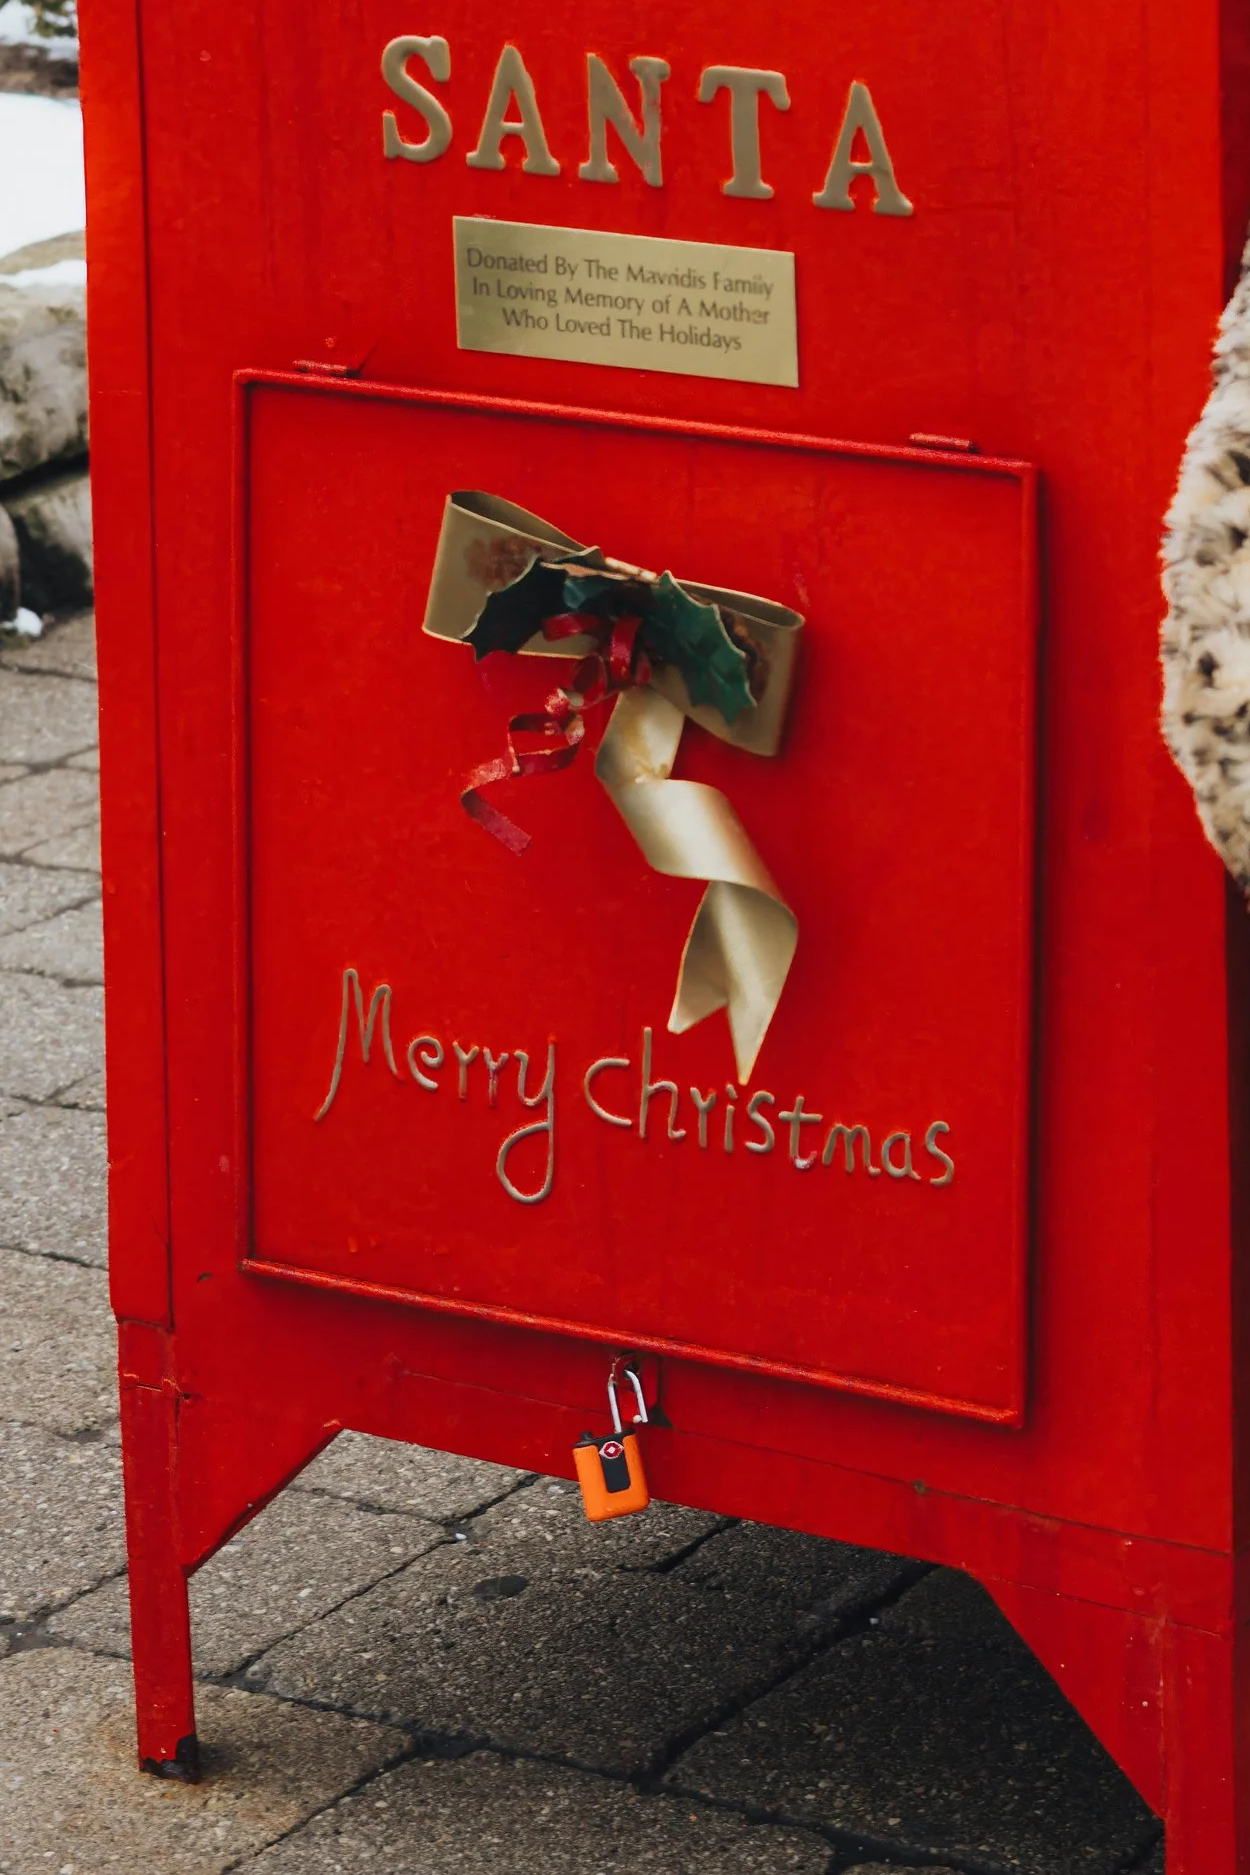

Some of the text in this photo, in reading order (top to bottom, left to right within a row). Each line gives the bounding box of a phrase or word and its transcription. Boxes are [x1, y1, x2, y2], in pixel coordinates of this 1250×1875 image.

[382, 35, 915, 217] SANTA
[466, 247, 775, 300] Donated By The Mavridis Family
[473, 277, 770, 325] In Loving Memory of A Mother
[502, 307, 742, 353] Who Loved The Holidays
[314, 967, 558, 1204] Merry
